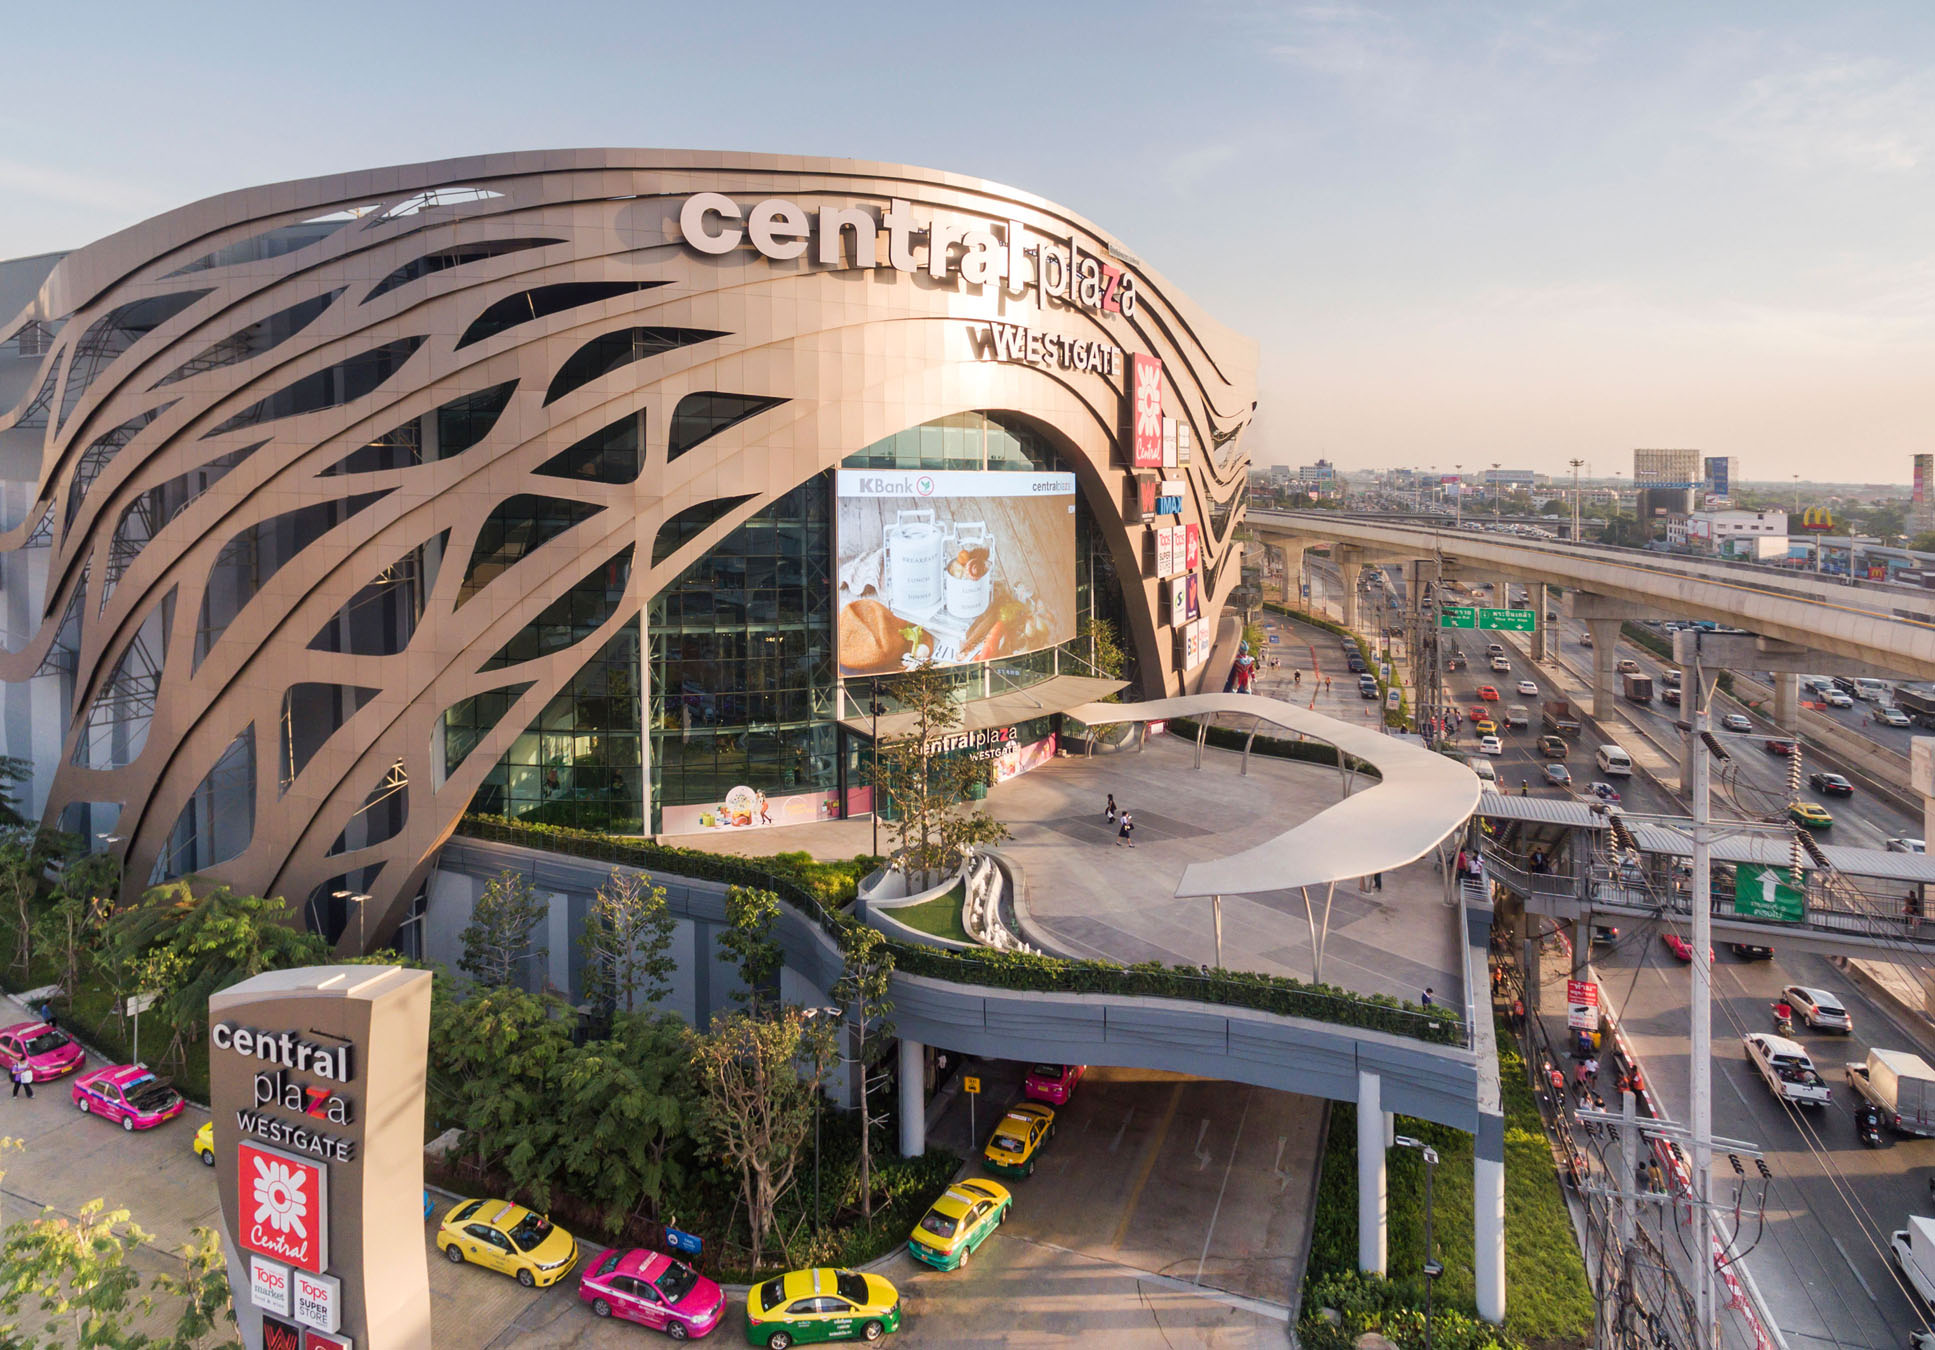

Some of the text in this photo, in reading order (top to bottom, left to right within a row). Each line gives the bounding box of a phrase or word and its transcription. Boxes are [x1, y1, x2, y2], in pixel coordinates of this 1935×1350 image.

[990, 321, 1121, 376] WESTGATE
[1136, 439, 1162, 461] Central
[859, 476, 913, 494] KBank
[1160, 496, 1182, 515] IMAX
[970, 745, 1019, 762] WESTGATE
[212, 1023, 348, 1083] central
[254, 1072, 348, 1126] plaza
[236, 1111, 349, 1163] WESTGATE
[251, 1225, 308, 1262] Central
[254, 1266, 285, 1289] Tops
[299, 1279, 328, 1302] Tops
[299, 1297, 328, 1315] SUPER
[299, 1306, 328, 1324] STORE
